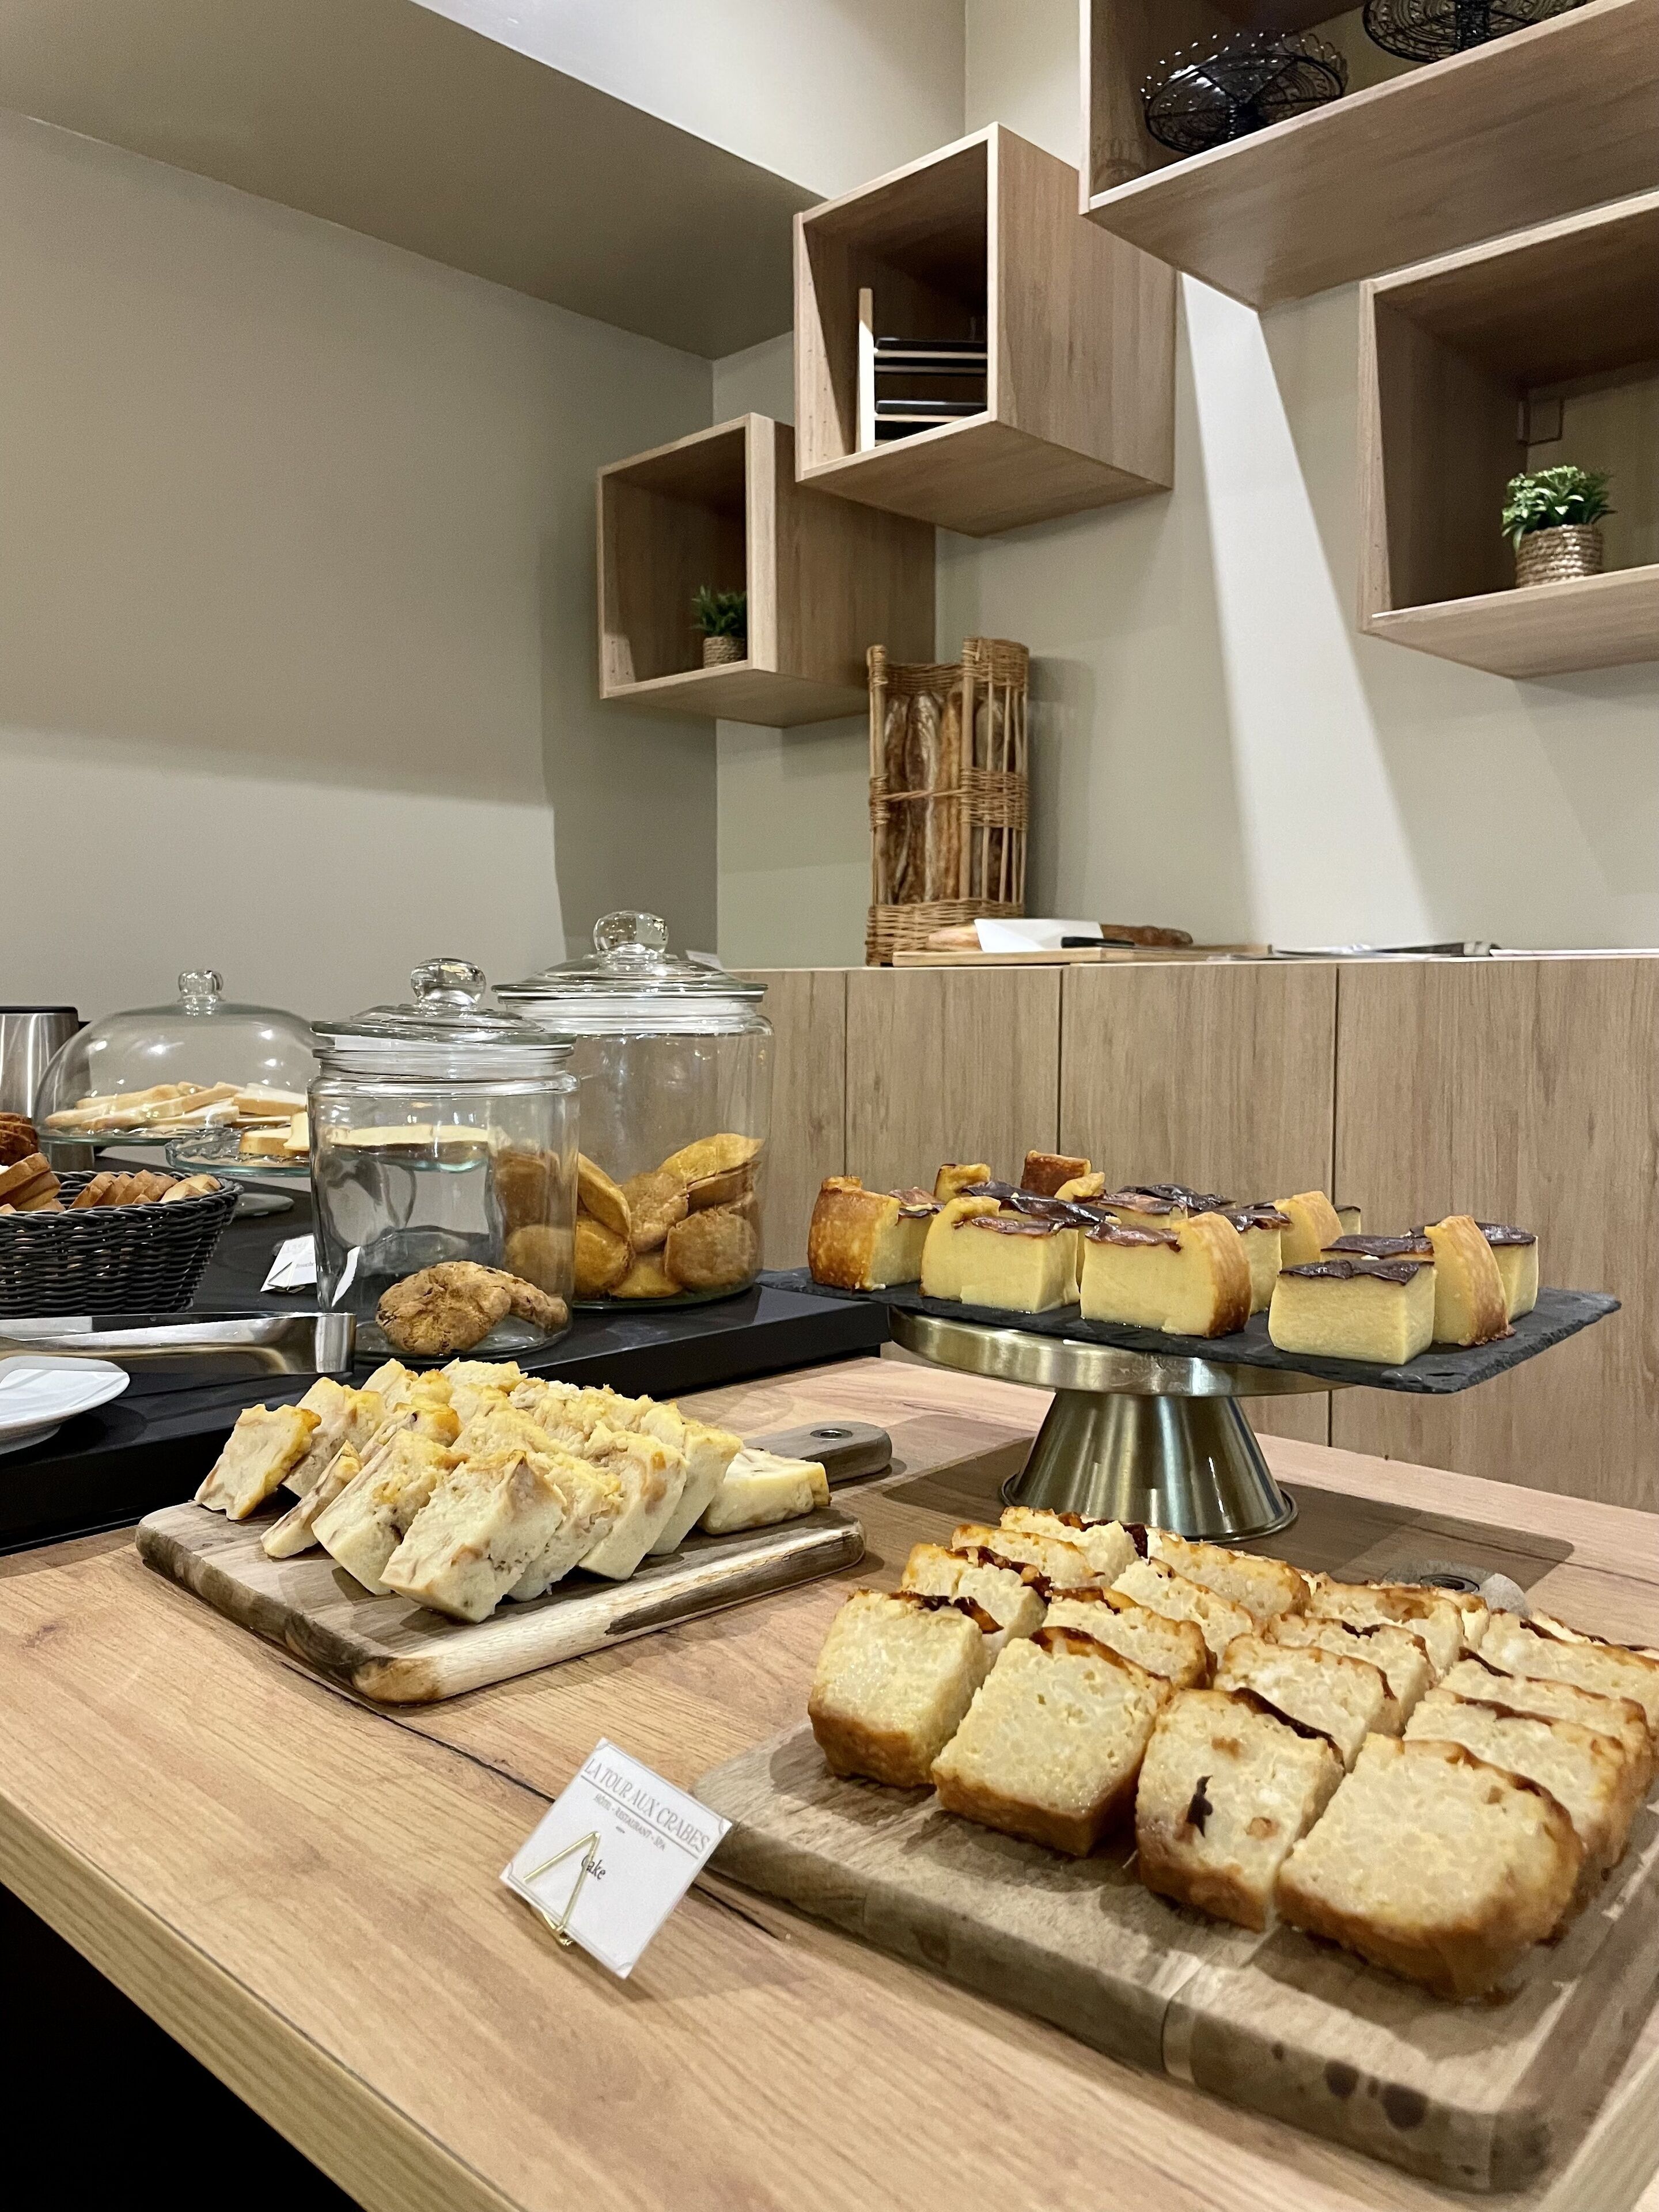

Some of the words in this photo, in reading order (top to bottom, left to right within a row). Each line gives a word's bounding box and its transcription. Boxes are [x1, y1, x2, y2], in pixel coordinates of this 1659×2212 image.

[584, 1759, 602, 1779] LA
[600, 1767, 632, 1798] TOUR
[628, 1789, 660, 1817] AUX
[656, 1808, 710, 1853] CRABES
